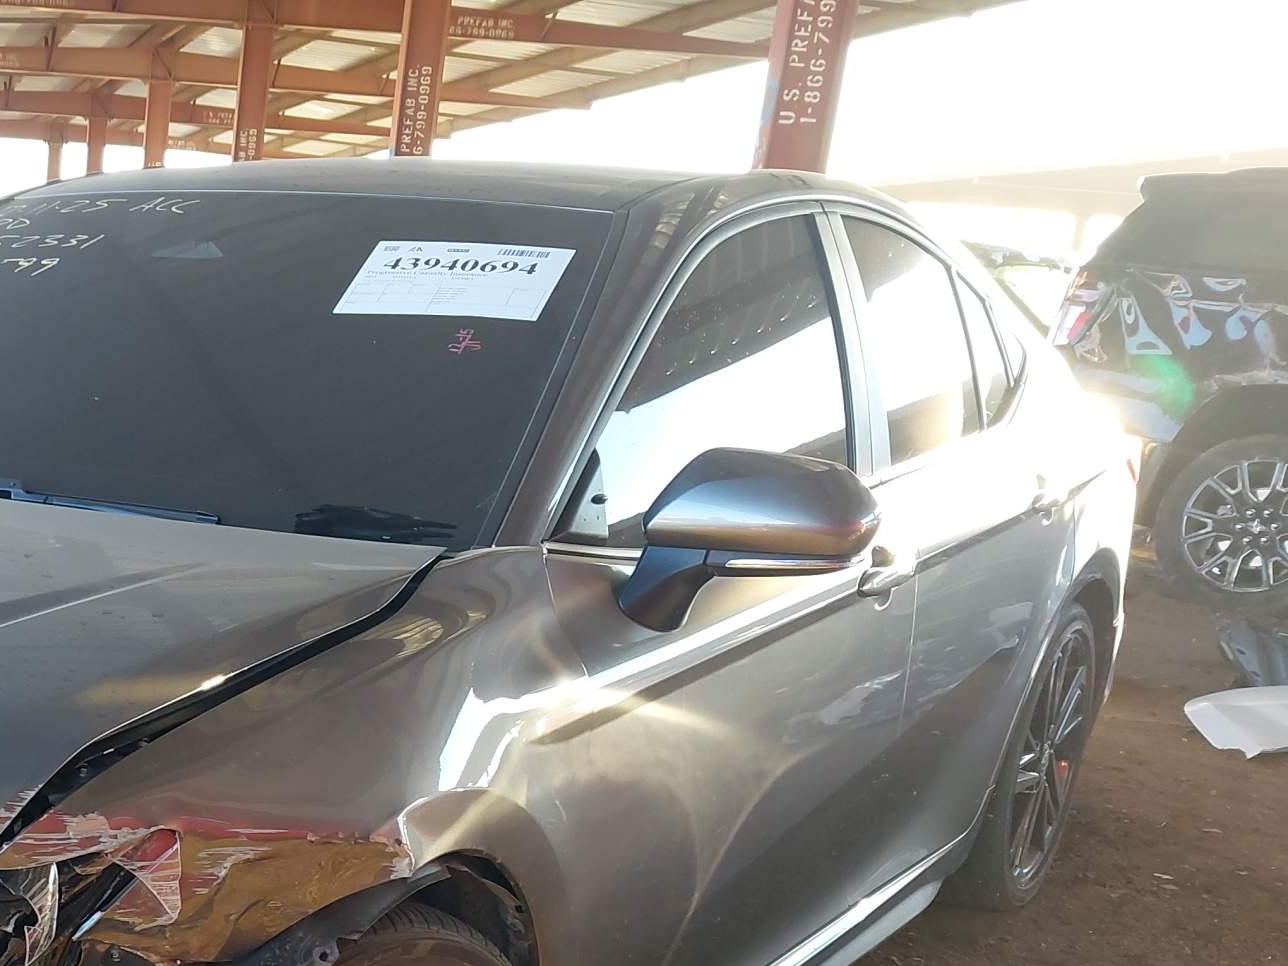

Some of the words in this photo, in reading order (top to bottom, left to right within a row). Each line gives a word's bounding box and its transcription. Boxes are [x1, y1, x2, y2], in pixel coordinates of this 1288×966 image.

[789, 0, 816, 67] PREF
[400, 98, 416, 153] PREFAB
[383, 256, 539, 276] 43940694
